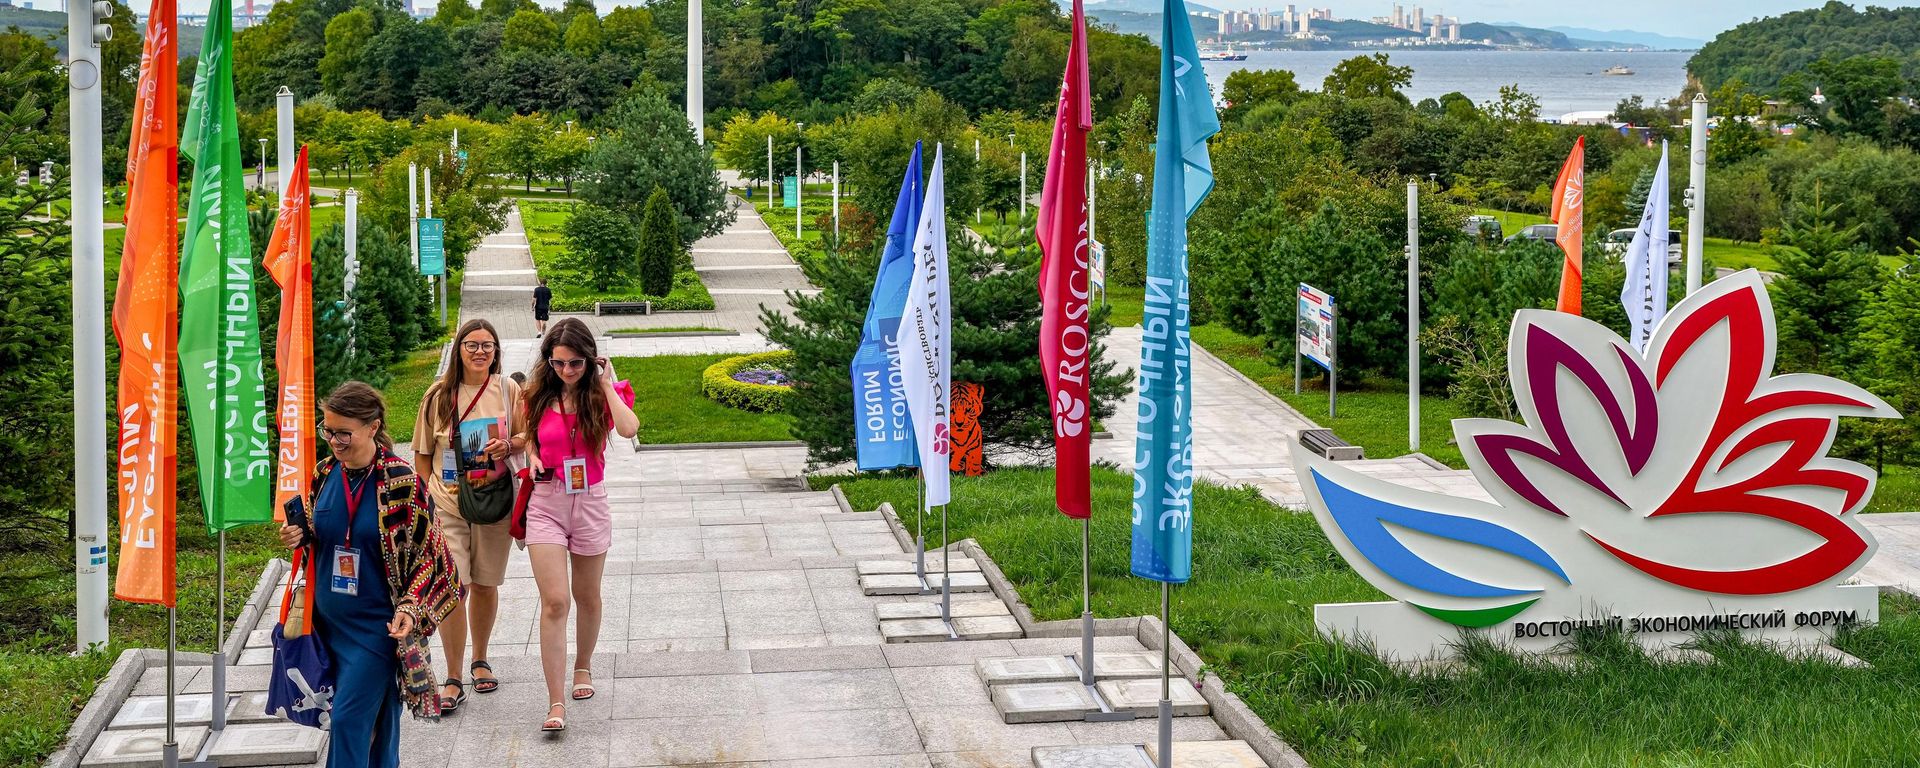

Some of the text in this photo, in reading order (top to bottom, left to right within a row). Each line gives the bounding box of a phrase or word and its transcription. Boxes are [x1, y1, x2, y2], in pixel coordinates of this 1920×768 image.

[224, 257, 250, 480] СТОЧНЫЙ
[1630, 609, 1787, 633] ЭКОНОМИЧЕСКИЙ
[1794, 609, 1857, 628] ФОРУМ
